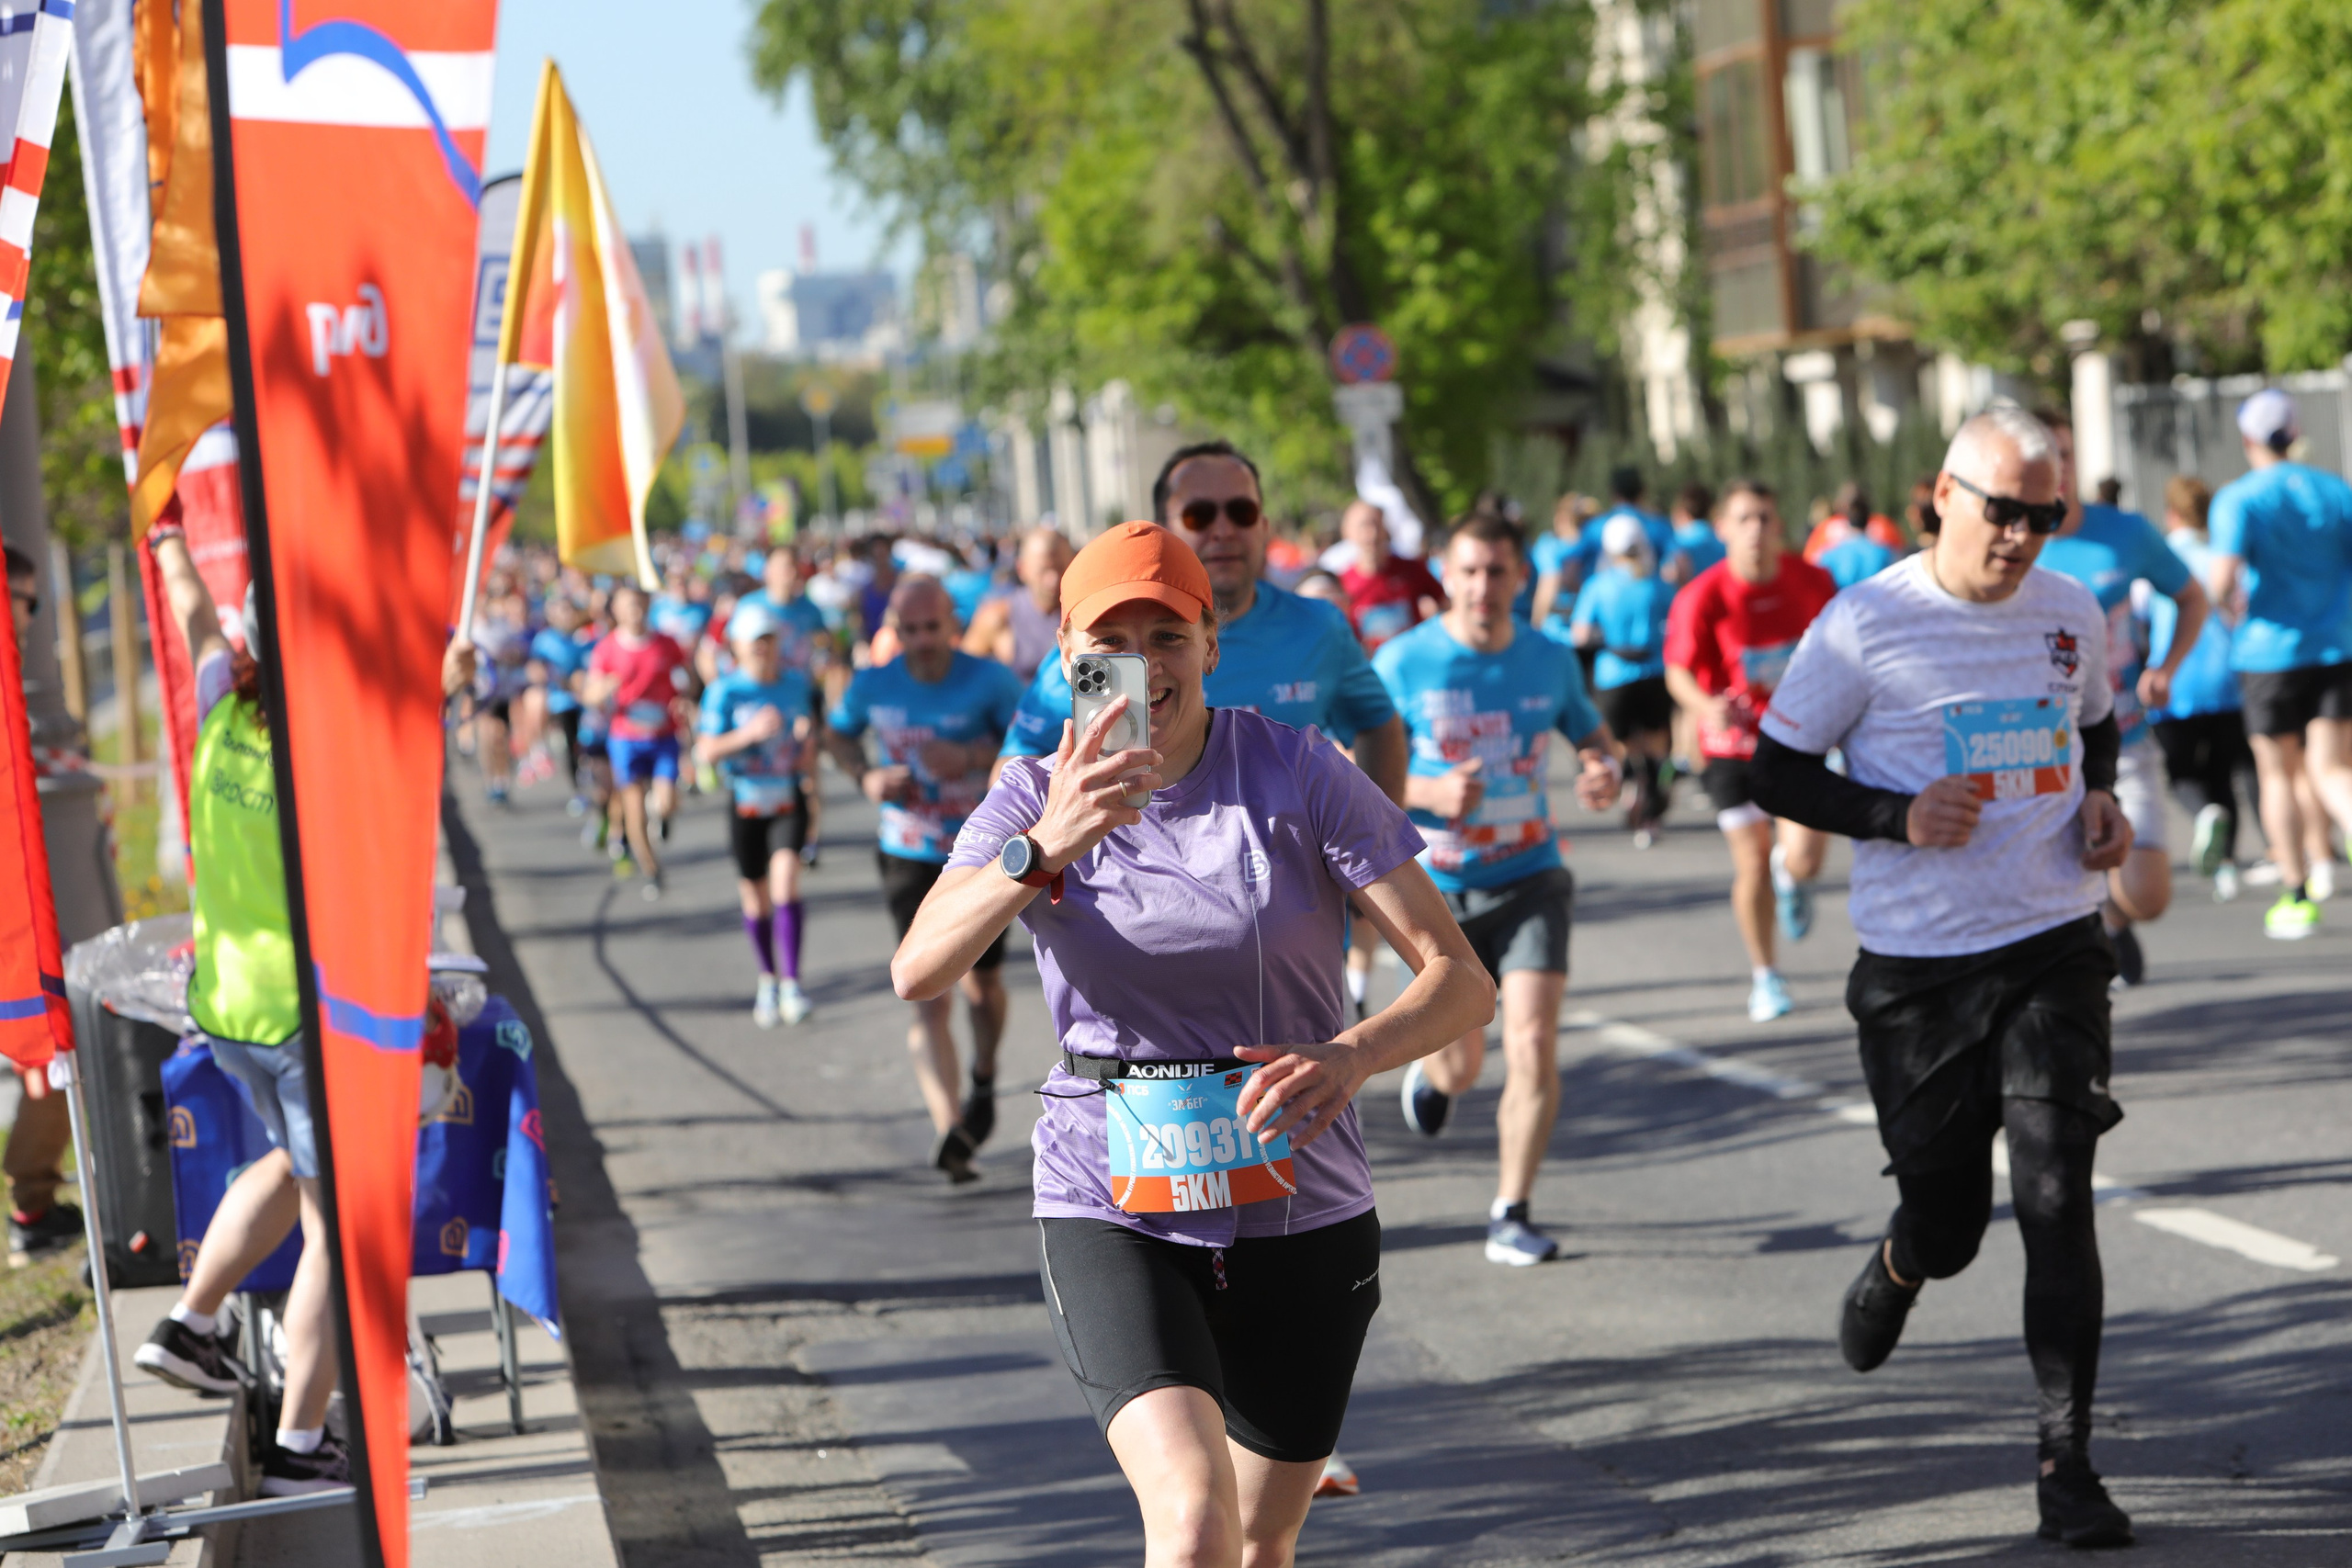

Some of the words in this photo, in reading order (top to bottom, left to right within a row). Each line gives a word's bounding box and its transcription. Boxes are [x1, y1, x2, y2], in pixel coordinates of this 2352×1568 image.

[1969, 727, 2052, 768] 25090
[1993, 768, 2036, 799] 5KM
[1125, 1063, 1215, 1078] AONIJIE
[1126, 1085, 1149, 1096] ПСБ
[1139, 1116, 1253, 1169] 20931
[1169, 1169, 1233, 1213] 5KM
